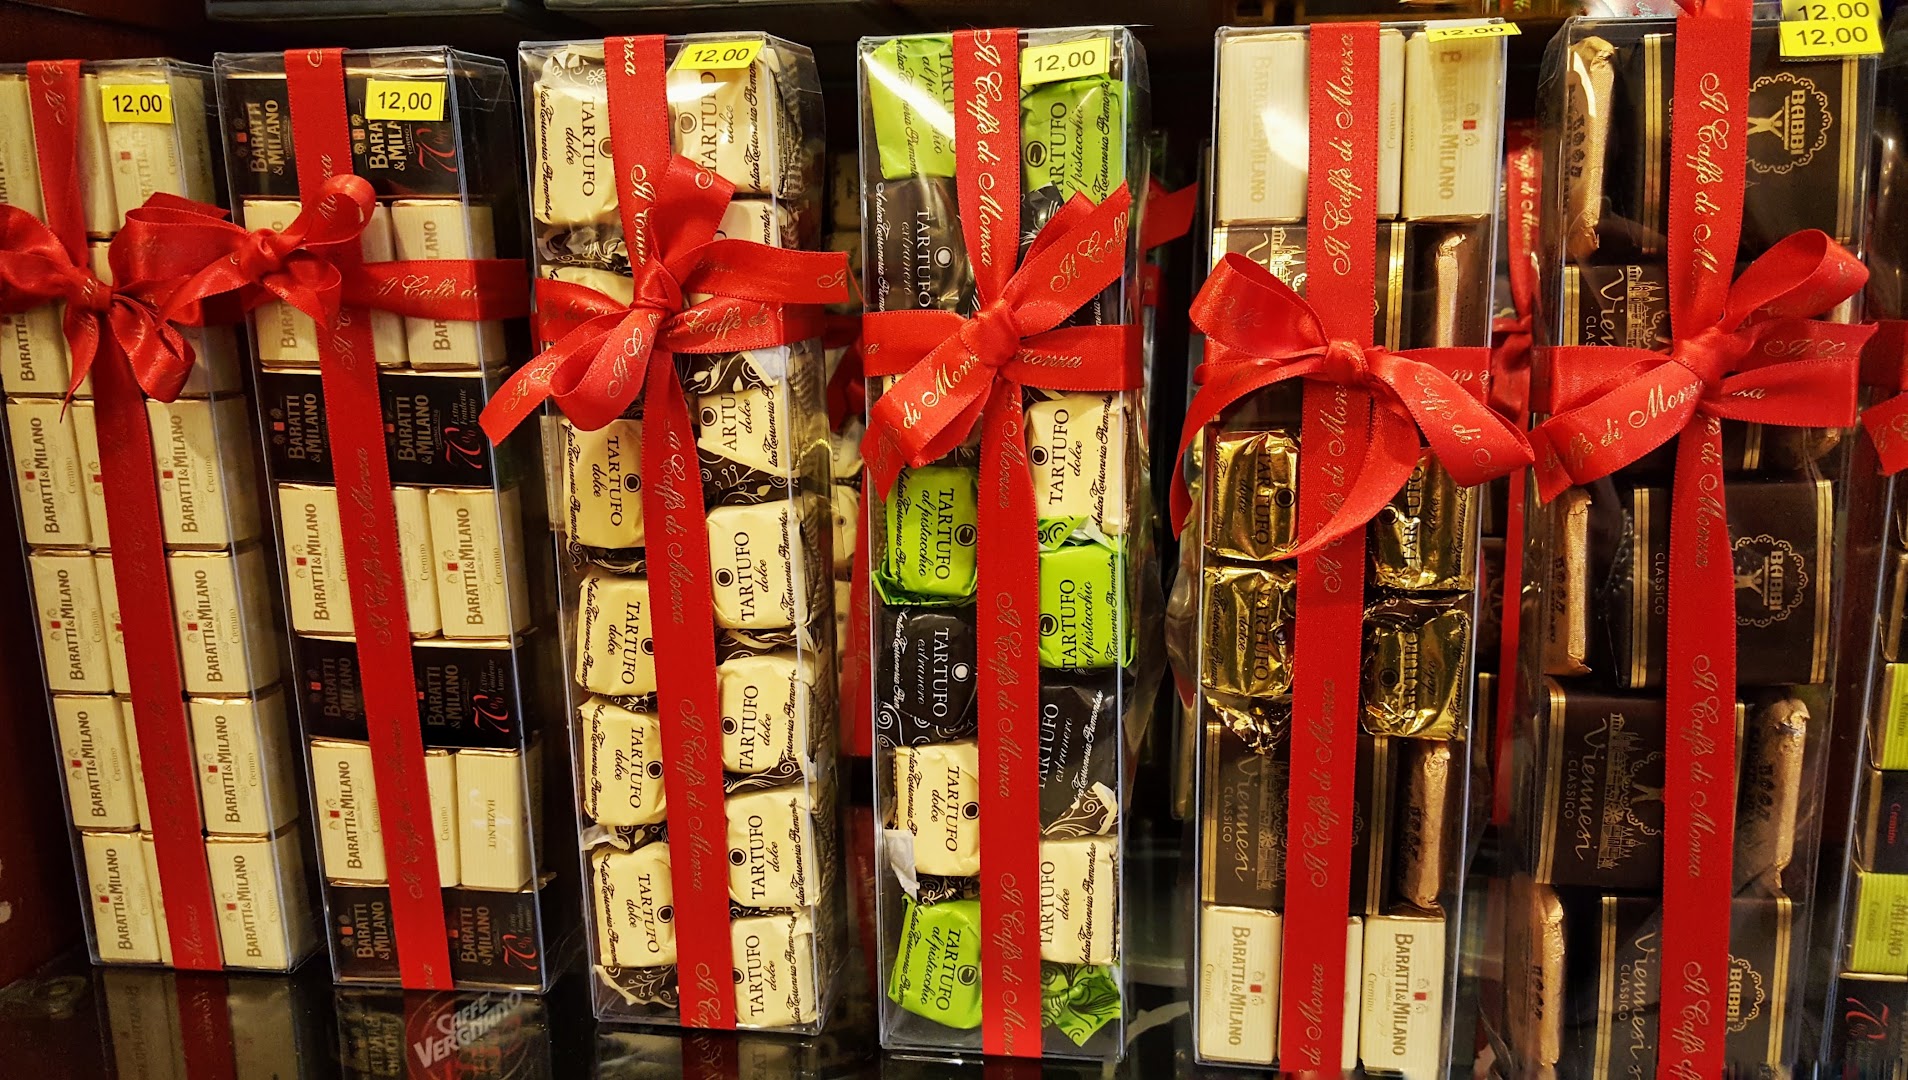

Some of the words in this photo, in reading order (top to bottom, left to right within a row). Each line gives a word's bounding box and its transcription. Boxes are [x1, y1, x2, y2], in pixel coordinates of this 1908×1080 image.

[694, 47, 750, 63] 12,00
[973, 30, 1001, 67] Il
[1034, 50, 1095, 72] 12,00
[1796, 26, 1868, 47] 12,00
[112, 94, 162, 115] 12,00
[378, 92, 432, 111] 12,00
[966, 72, 1002, 134] Caffè
[1326, 33, 1355, 130] Monza
[249, 101, 268, 173] BARATTI
[565, 127, 578, 165] dolce
[581, 96, 596, 197] TARTUFO
[976, 139, 999, 166] di
[1329, 137, 1353, 163] di
[1686, 118, 1730, 185] Caffè
[1790, 90, 1806, 155] BABBI
[978, 172, 1003, 267] Monza
[1322, 165, 1363, 227] Caffè
[1694, 191, 1721, 216] di
[902, 221, 911, 294] extranero
[917, 207, 932, 307] TARTUFO
[685, 305, 742, 340] Caffè
[287, 395, 305, 460] BARATTI
[397, 397, 416, 461] BARATTI
[737, 398, 752, 434] dolce
[903, 402, 921, 429] di
[30, 417, 60, 533] BARATTI&MILANO
[170, 415, 199, 533] BARATTI&MILANO
[591, 463, 605, 498] dolce
[607, 436, 622, 527] TARTUFO
[1049, 409, 1069, 505] TARTUFO
[1067, 440, 1083, 476] dolce
[920, 489, 937, 505] al
[1696, 474, 1723, 568] Monza
[304, 503, 330, 622] BARATTI&MILANO
[456, 507, 484, 626] BARATTI&MILANO
[915, 504, 934, 578] pistacchio
[934, 488, 955, 580] TARTUFO
[666, 542, 694, 625] Monza
[735, 532, 755, 621] TARTUFO
[755, 559, 768, 593] dolce
[1655, 552, 1666, 616] CLASSICO
[1768, 550, 1784, 611] BABBI
[57, 569, 85, 680] BARATTI&MILANO
[195, 570, 223, 682] BARATTI&MILANO
[608, 624, 622, 655] dolce
[621, 601, 641, 685] TARTUFO
[1060, 579, 1076, 668] TARTUFO
[1078, 580, 1100, 651] pistacchio
[917, 638, 930, 705] extranero
[932, 627, 949, 717] TARTUFO
[989, 632, 1022, 686] Caffè
[1078, 650, 1094, 666] al
[426, 666, 446, 727] BARATTI
[739, 685, 758, 770] TARTUFO
[758, 712, 773, 746] dolce
[997, 690, 1020, 716] di
[1309, 679, 1336, 763] Monza
[1680, 695, 1720, 763] Caffè
[77, 711, 107, 817] BARATTI&MILANO
[215, 715, 241, 823] BARATTI&MILANO
[614, 748, 628, 780] dolce
[629, 727, 644, 808] TARTUFO
[997, 717, 1022, 799] Monza
[1055, 717, 1072, 783] extranero
[1309, 768, 1332, 792] di
[1690, 761, 1713, 785] di
[337, 760, 363, 869] BARATTI&MILANO
[931, 789, 945, 823] dolce
[945, 766, 960, 851] TARTUFO
[1222, 786, 1233, 843] CLASSICO
[1302, 793, 1340, 847] Caffè
[1564, 760, 1577, 819] CLASSICO
[1575, 718, 1608, 860] Viennesi
[487, 799, 496, 849] HAZELNUT
[688, 818, 712, 892] Monza
[766, 841, 779, 872] dolce
[1688, 790, 1717, 878] Monza
[748, 815, 765, 899] TARTUFO
[107, 848, 133, 950] BARATTI&MILANO
[233, 855, 263, 958] BARATTI&MILANO
[354, 903, 376, 959] BARATTI
[626, 899, 640, 928] dolce
[638, 873, 660, 954] TARTUFO
[1040, 861, 1055, 946] TARTUFO
[1055, 888, 1070, 920] dolce
[460, 907, 480, 964] BARATTI
[993, 907, 1025, 960] Caffè
[745, 934, 764, 1017] TARTUFO
[763, 960, 777, 991] dolce
[919, 937, 940, 1005] pistacchio
[936, 928, 961, 1011] TARTUFO
[1003, 966, 1022, 988] di
[1229, 926, 1250, 1046] BARATTI&MILANO
[1297, 963, 1324, 1041] Monza
[1392, 933, 1413, 1056] BARATTI&MILANO
[1618, 965, 1630, 1021] CLASSICO
[1728, 968, 1743, 1024] BABBI
[1305, 1042, 1322, 1067] di
